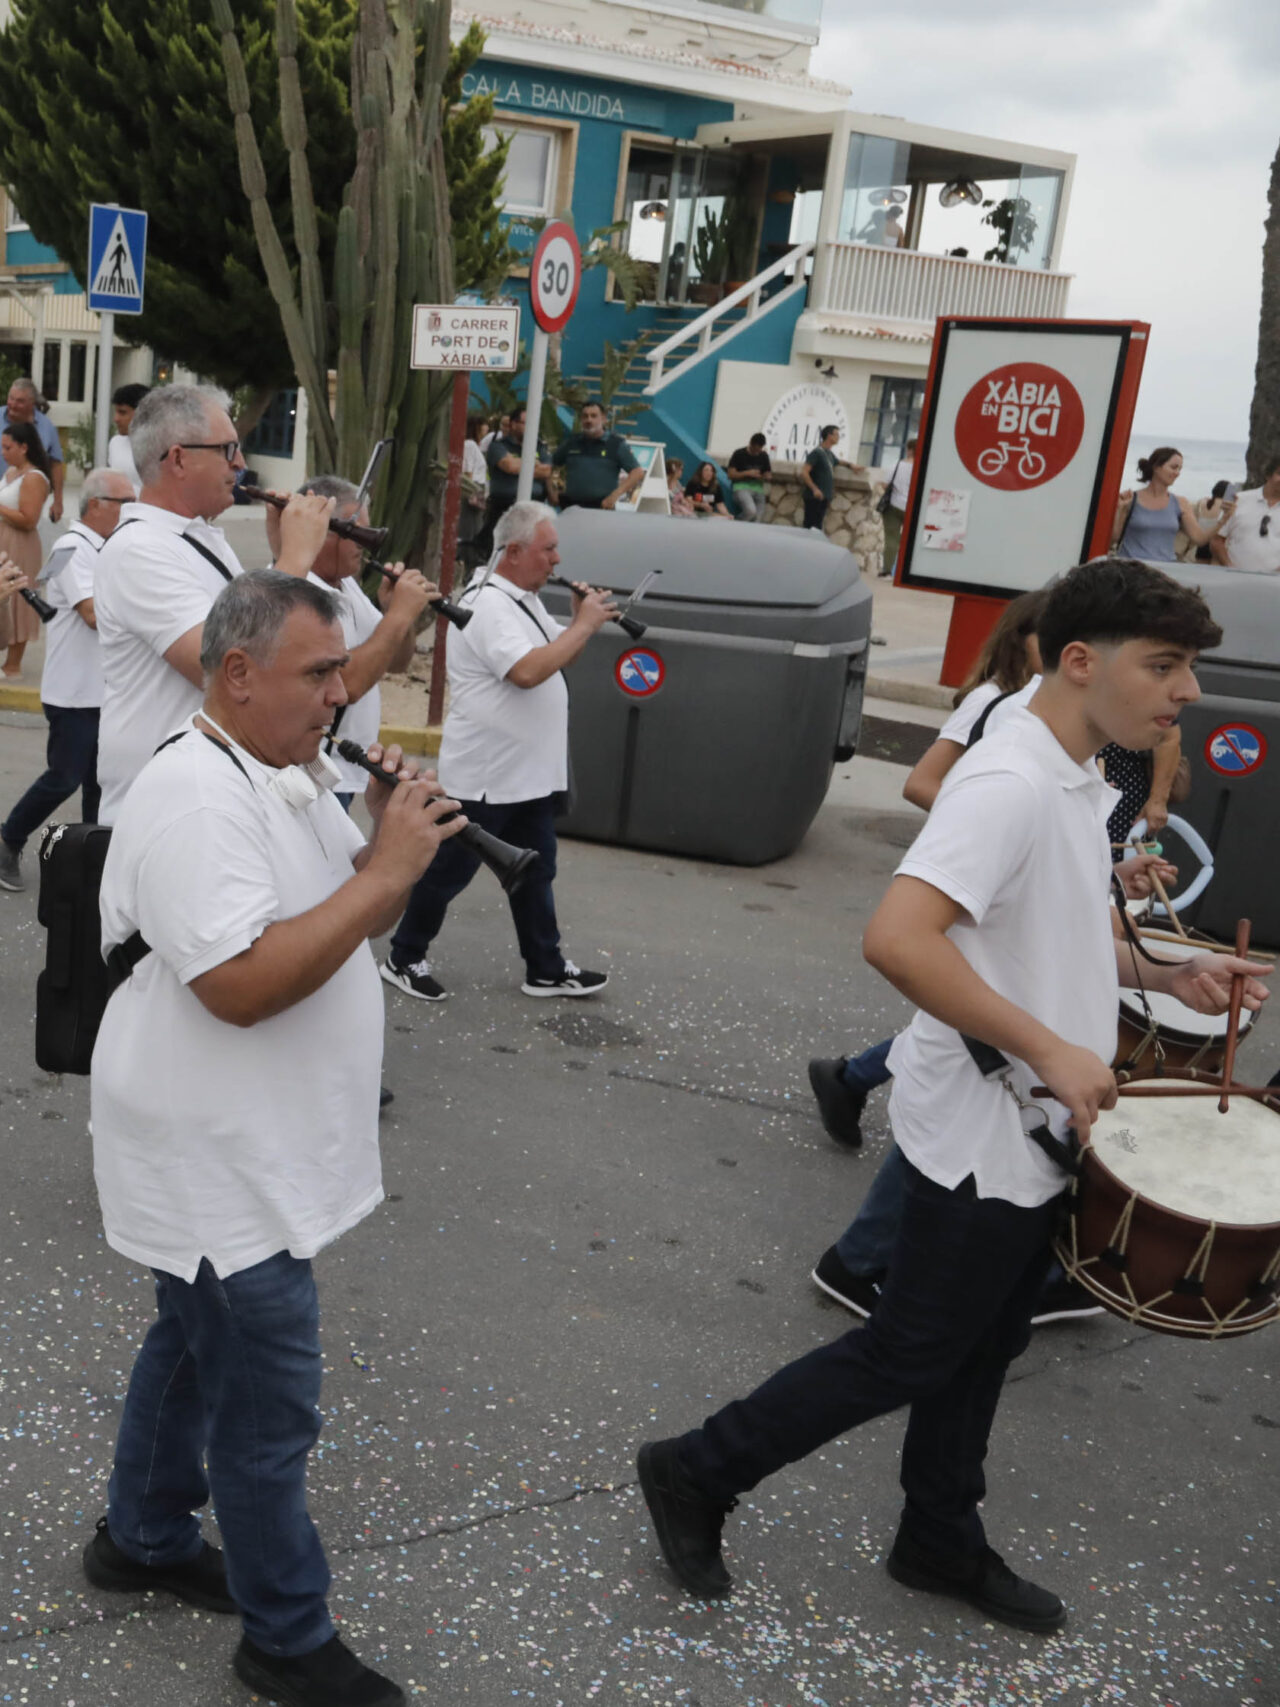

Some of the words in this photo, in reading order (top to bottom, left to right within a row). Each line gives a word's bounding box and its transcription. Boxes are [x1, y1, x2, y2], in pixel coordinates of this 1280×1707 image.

[461, 73, 521, 104] CALA
[531, 82, 625, 120] BANDIDA
[542, 259, 569, 297] 30
[451, 319, 508, 330] CARRER
[431, 335, 473, 348] PRT
[478, 336, 499, 349] DE
[440, 351, 486, 366] XÀBIA
[984, 376, 1062, 408] XÀBIA
[766, 387, 809, 436] BREAKFAST
[981, 403, 999, 417] EN
[997, 404, 1061, 438] BICI
